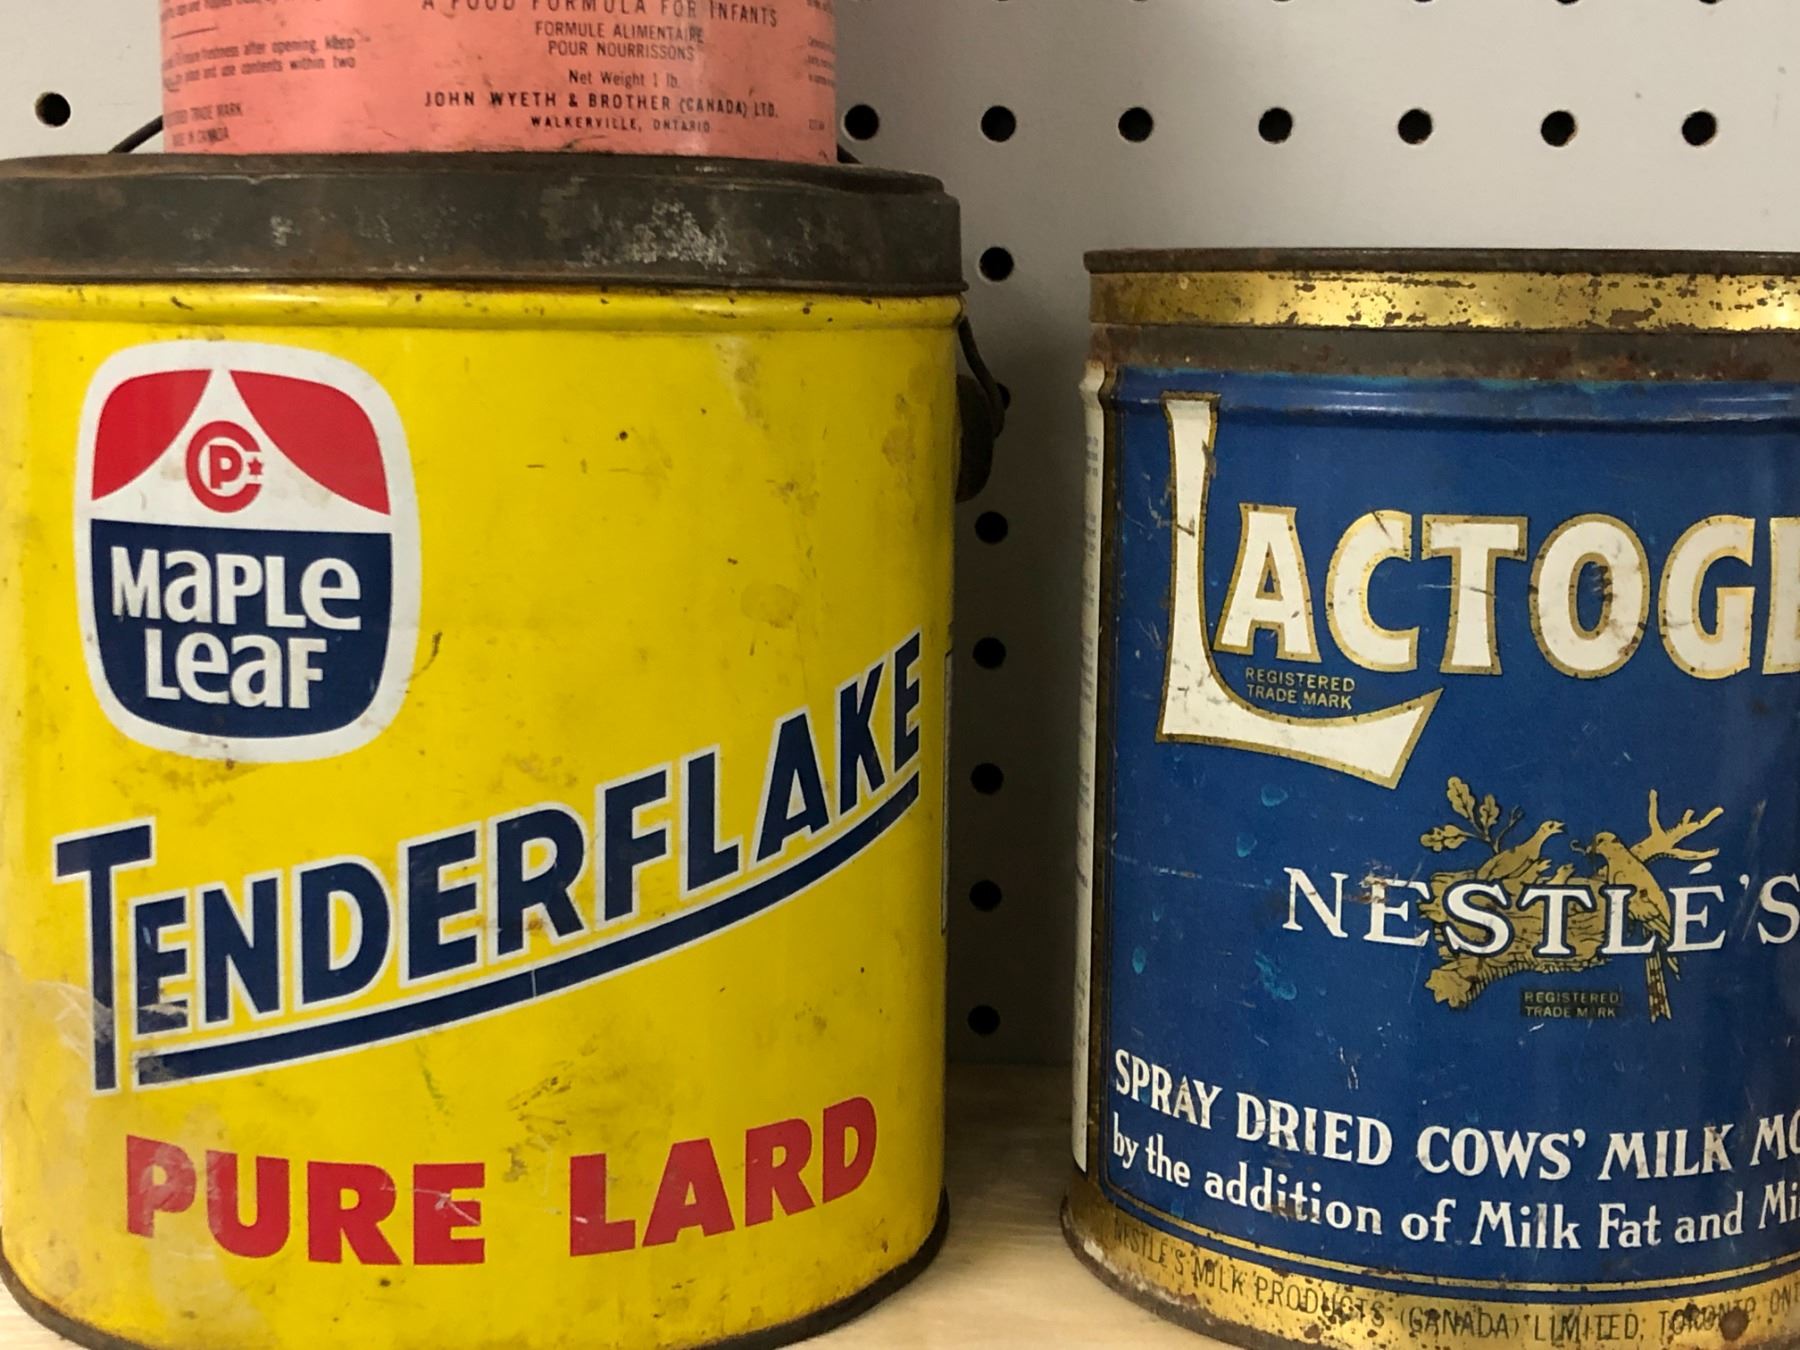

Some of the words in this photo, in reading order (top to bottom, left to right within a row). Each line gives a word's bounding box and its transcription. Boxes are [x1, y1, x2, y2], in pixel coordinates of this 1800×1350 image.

[532, 0, 647, 15] FORMULA
[660, 0, 697, 18] FOR
[710, 0, 778, 28] INFANTS
[535, 20, 605, 38] FORMULE
[613, 23, 704, 44] ALIMENTAIRE
[548, 40, 588, 56] POUR
[597, 41, 695, 62] NOURRISSONS
[568, 69, 593, 85] Net
[600, 71, 646, 90] Weight
[424, 91, 476, 108] JOHN
[489, 91, 557, 108] WYETH
[567, 92, 579, 109] &
[588, 93, 671, 111] BROTHER
[679, 97, 749, 119] (CANADA)
[753, 101, 779, 119] LTD.
[530, 115, 643, 133] WALKERVILLE,
[652, 119, 712, 134] ONTARIO
[1245, 667, 1356, 692] REGISTERED
[1246, 684, 1298, 704] TRADE
[1303, 691, 1353, 711] MARK
[54, 627, 922, 1096] TENDERFLAKE
[1282, 861, 1800, 957] NESTLÉ'S
[1524, 990, 1620, 1004] REGISTERED
[1525, 1005, 1572, 1018] TRADE
[1576, 1006, 1617, 1018] MRK
[1114, 1048, 1223, 1131] SPRAY
[1236, 1091, 1394, 1167] DRIED
[1416, 1124, 1587, 1181] COWS'
[1597, 1123, 1735, 1182] MILK
[125, 1134, 487, 1267] PURE
[569, 1095, 877, 1257] LARD
[1112, 1111, 1140, 1170] by
[1145, 1133, 1192, 1189] the
[1203, 1161, 1383, 1236] addition
[1401, 1198, 1457, 1243] of
[1469, 1200, 1582, 1250] Milk
[1598, 1202, 1662, 1250] Fat
[1673, 1190, 1744, 1245] and
[1192, 1255, 1246, 1297] MILK
[1254, 1275, 1386, 1328] PRODUCTS
